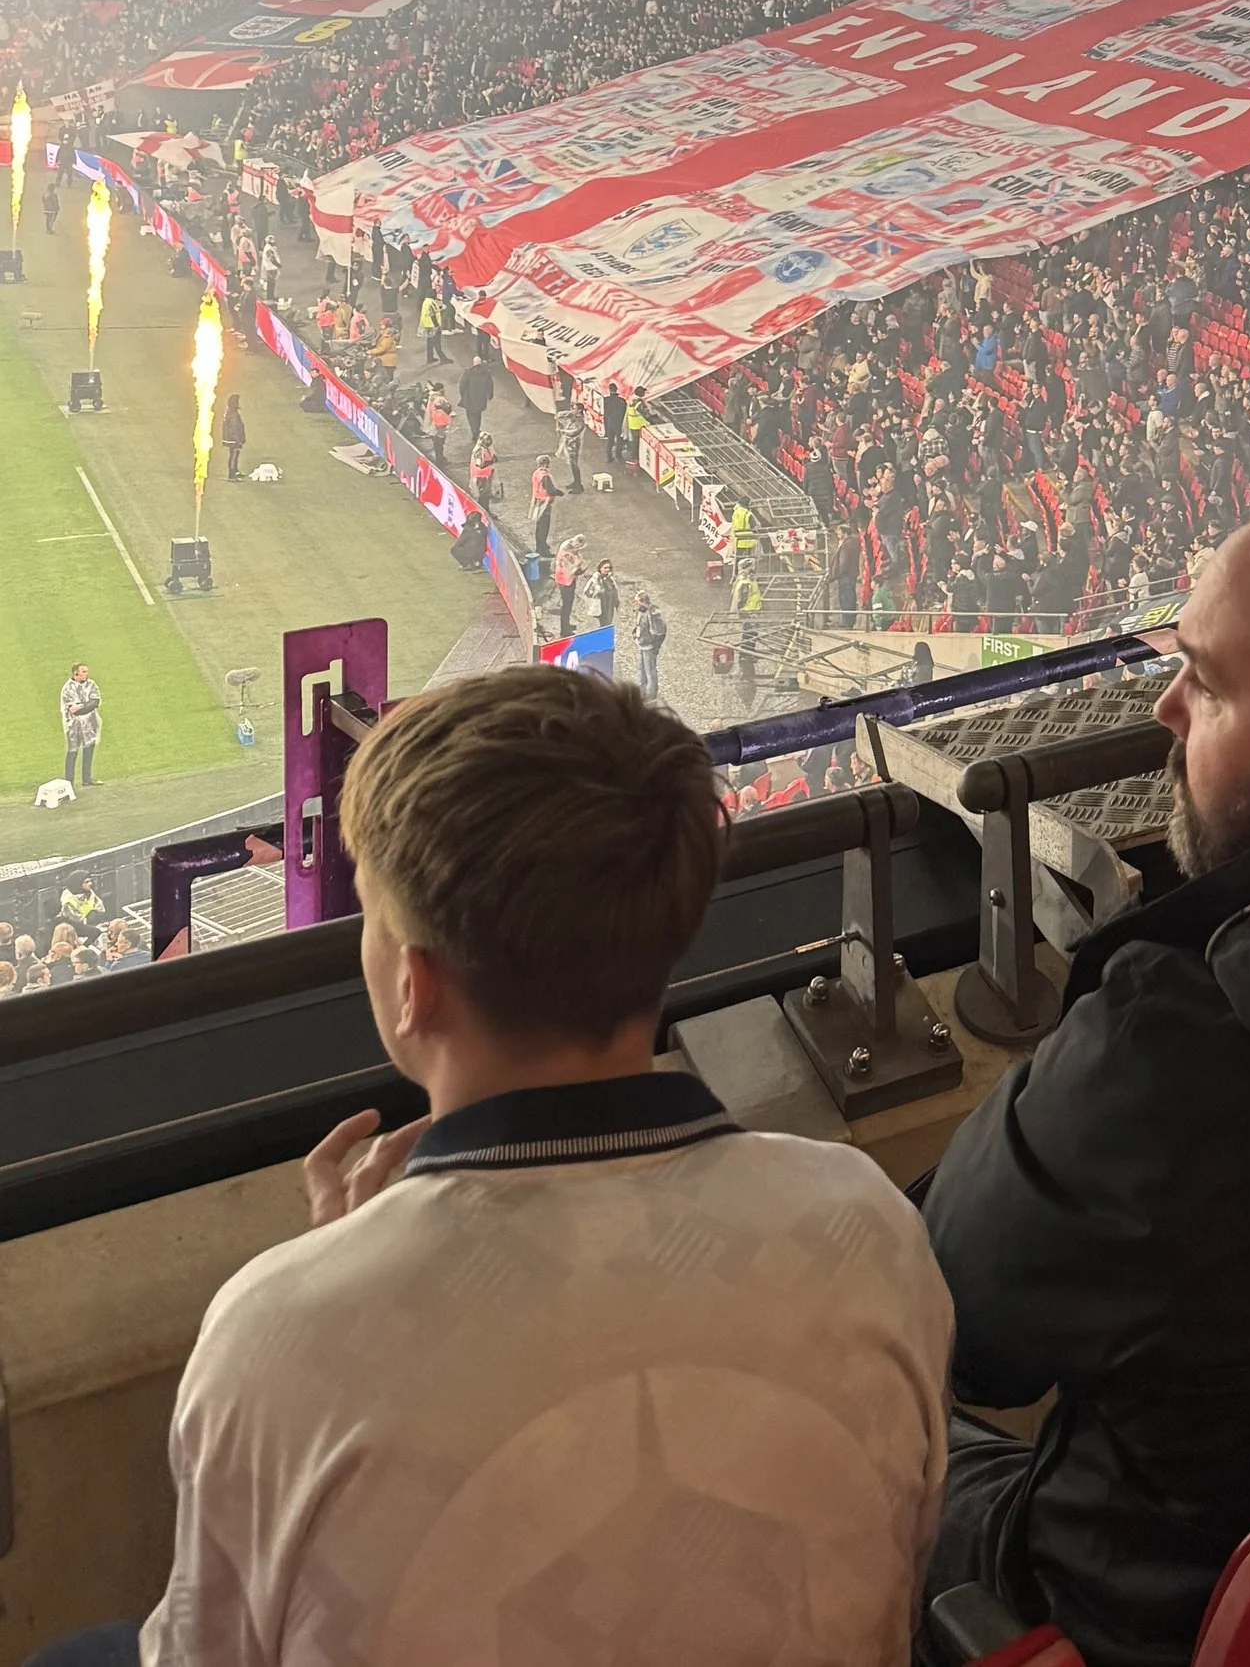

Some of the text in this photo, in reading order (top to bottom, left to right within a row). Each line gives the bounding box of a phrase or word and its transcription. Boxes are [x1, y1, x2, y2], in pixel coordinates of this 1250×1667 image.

[551, 325, 578, 344] FILL
[574, 333, 601, 349] UP
[983, 636, 1021, 659] FIRST
